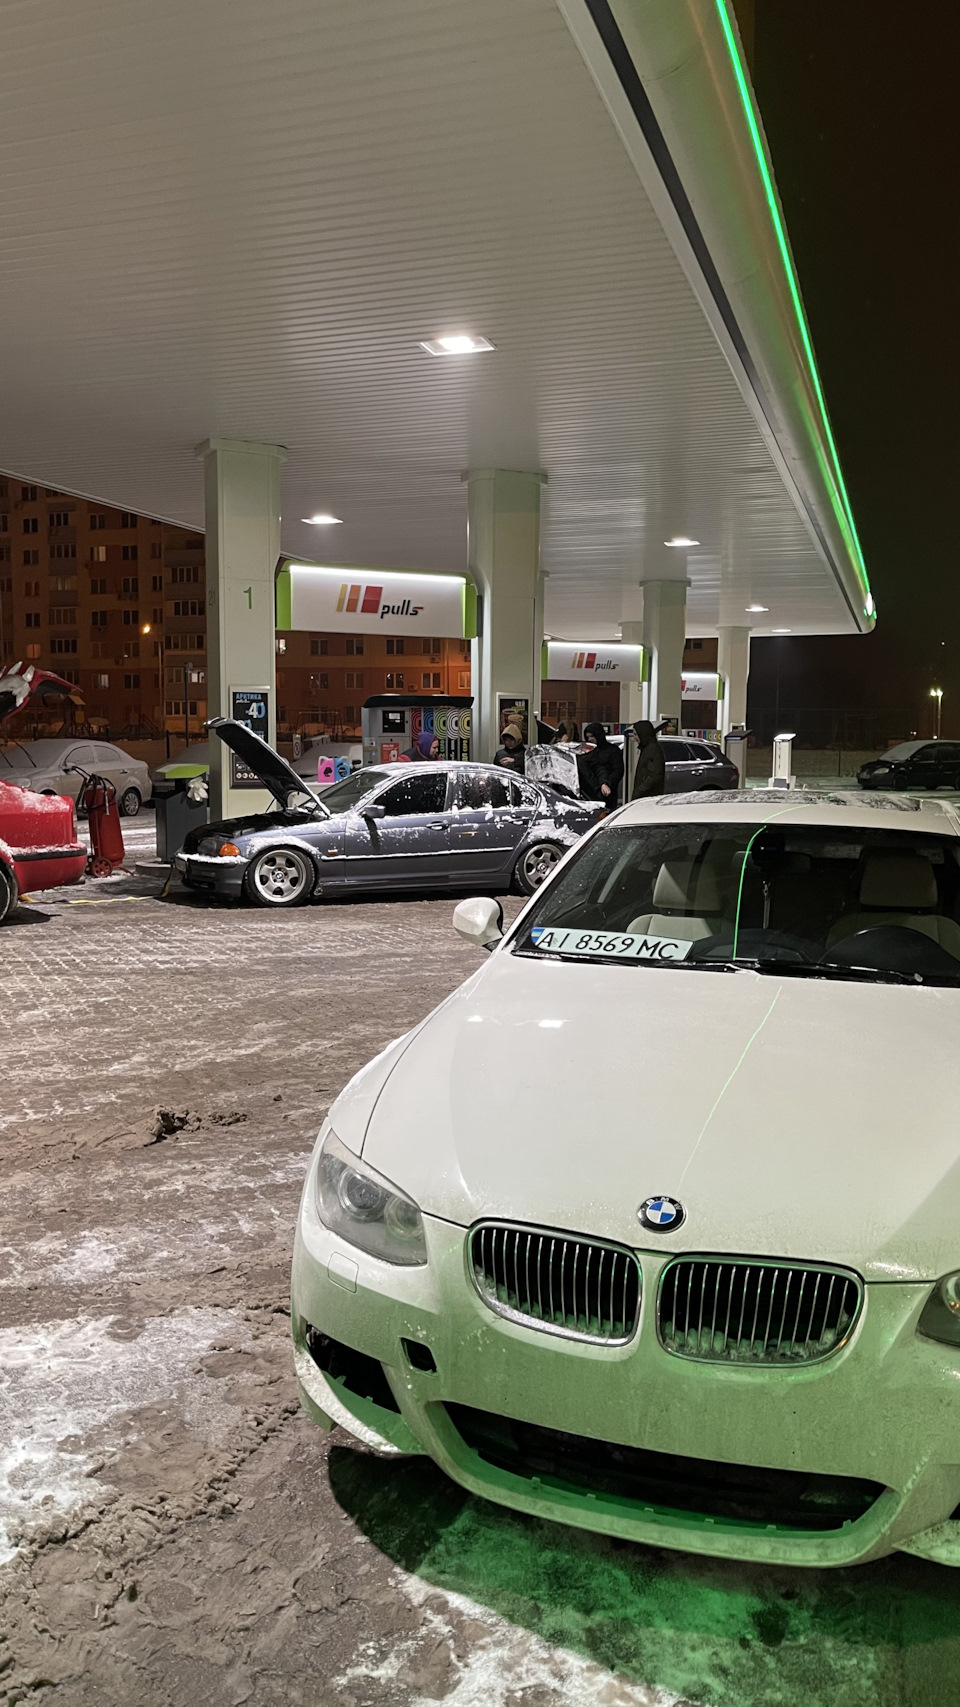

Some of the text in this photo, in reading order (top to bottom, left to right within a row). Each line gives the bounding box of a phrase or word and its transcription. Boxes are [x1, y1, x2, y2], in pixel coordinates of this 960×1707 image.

[243, 586, 252, 610] 1
[380, 599, 424, 619] pulls
[595, 660, 619, 672] pulls
[685, 685, 702, 693] pulls
[575, 934, 635, 954] 8569
[636, 938, 679, 960] MC
[645, 1196, 682, 1211] BMW
